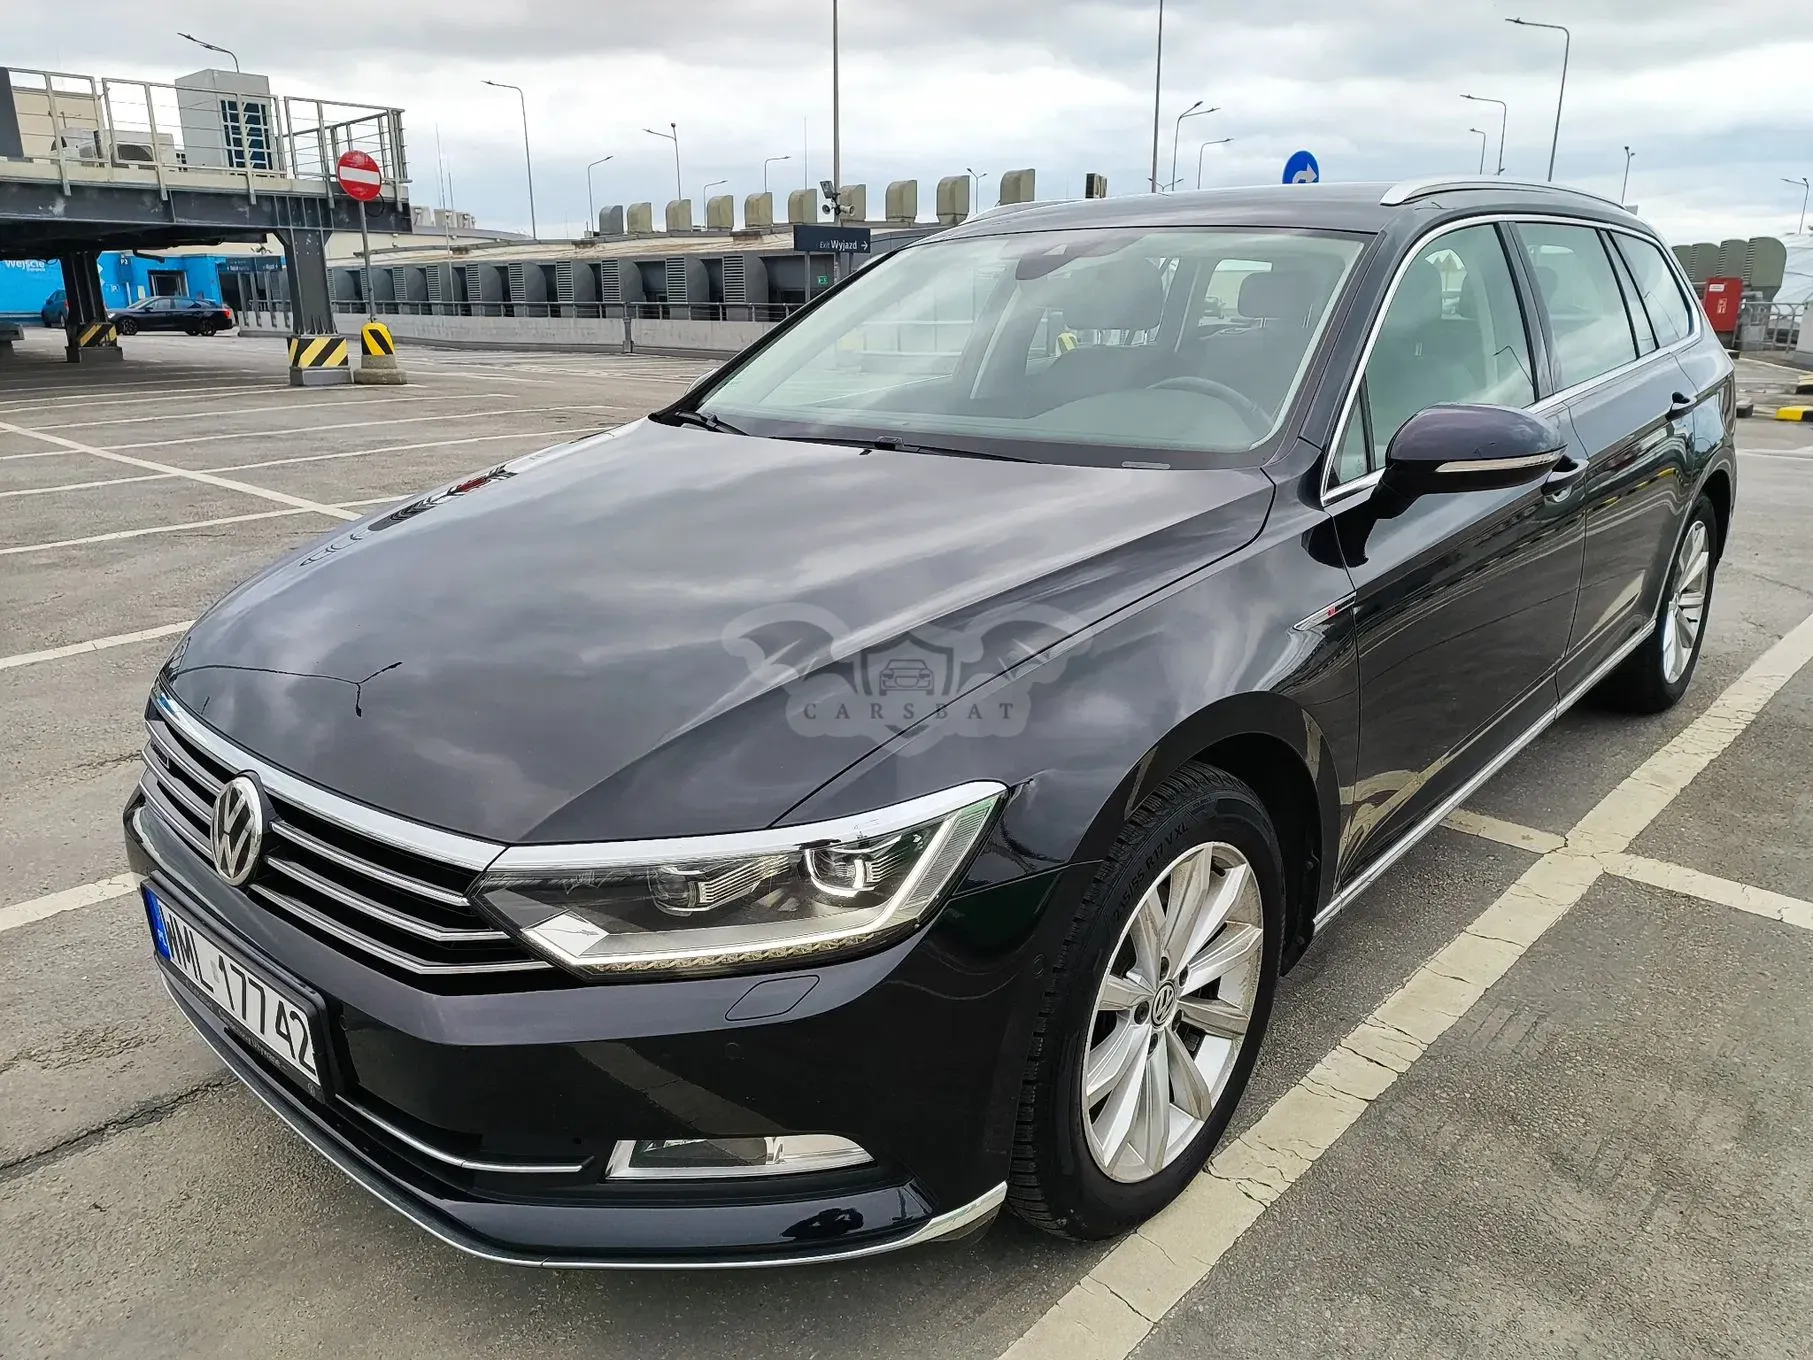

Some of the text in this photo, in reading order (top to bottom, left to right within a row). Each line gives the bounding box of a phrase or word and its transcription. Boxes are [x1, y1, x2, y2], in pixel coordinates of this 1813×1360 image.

[830, 239, 857, 251] Wyjazd
[1112, 869, 1145, 922] 215/55
[158, 904, 317, 1076] NML 17742
